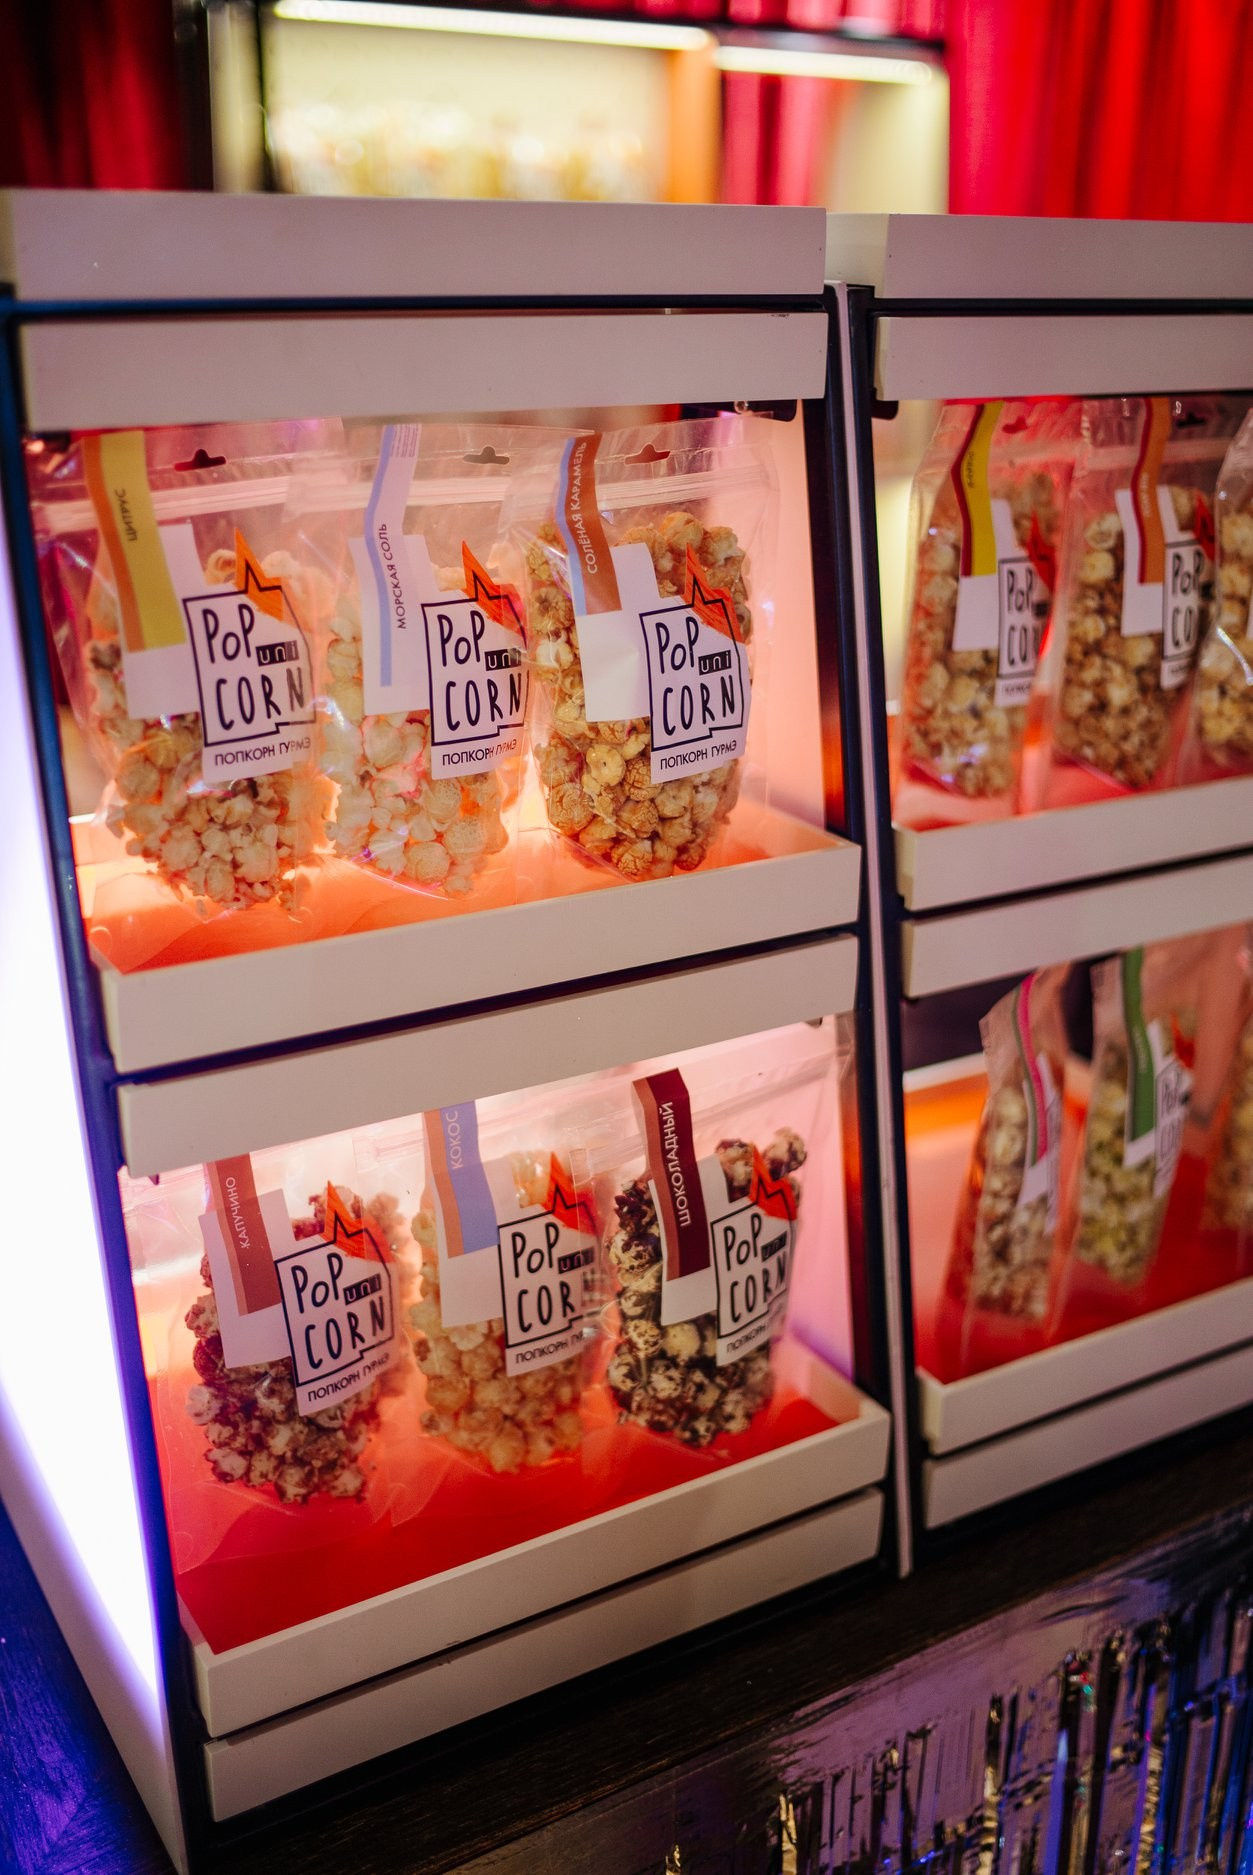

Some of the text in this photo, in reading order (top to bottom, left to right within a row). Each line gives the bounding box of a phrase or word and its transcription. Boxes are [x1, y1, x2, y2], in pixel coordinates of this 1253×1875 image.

[113, 488, 138, 542] ЦИТРУС
[569, 440, 599, 576] СОЛЁНАЯ КАРАМЕЛЬ
[376, 522, 407, 630] МОРСКАЯ СОЛЬ
[258, 641, 298, 664] uni
[700, 651, 731, 673] uni
[216, 667, 305, 730] CORN
[445, 673, 522, 731] CORN
[662, 675, 735, 736] CORN
[214, 736, 311, 767] ПОПКОРН ГУРМЭ
[442, 746, 495, 766] ПОПКОРН
[660, 739, 737, 771] ПОПКОРН ГУРМЭ
[445, 1110, 464, 1170] КОКОС
[658, 1101, 692, 1228] ШОКОЛАДНЫЙ
[225, 1175, 251, 1249] КАПУЧИНО
[345, 1277, 380, 1302] uni
[730, 1251, 786, 1323] CORN
[305, 1296, 385, 1370] CORN
[515, 1339, 568, 1364] ПОПКОРН
[308, 1370, 361, 1402] ПОПКОРН
